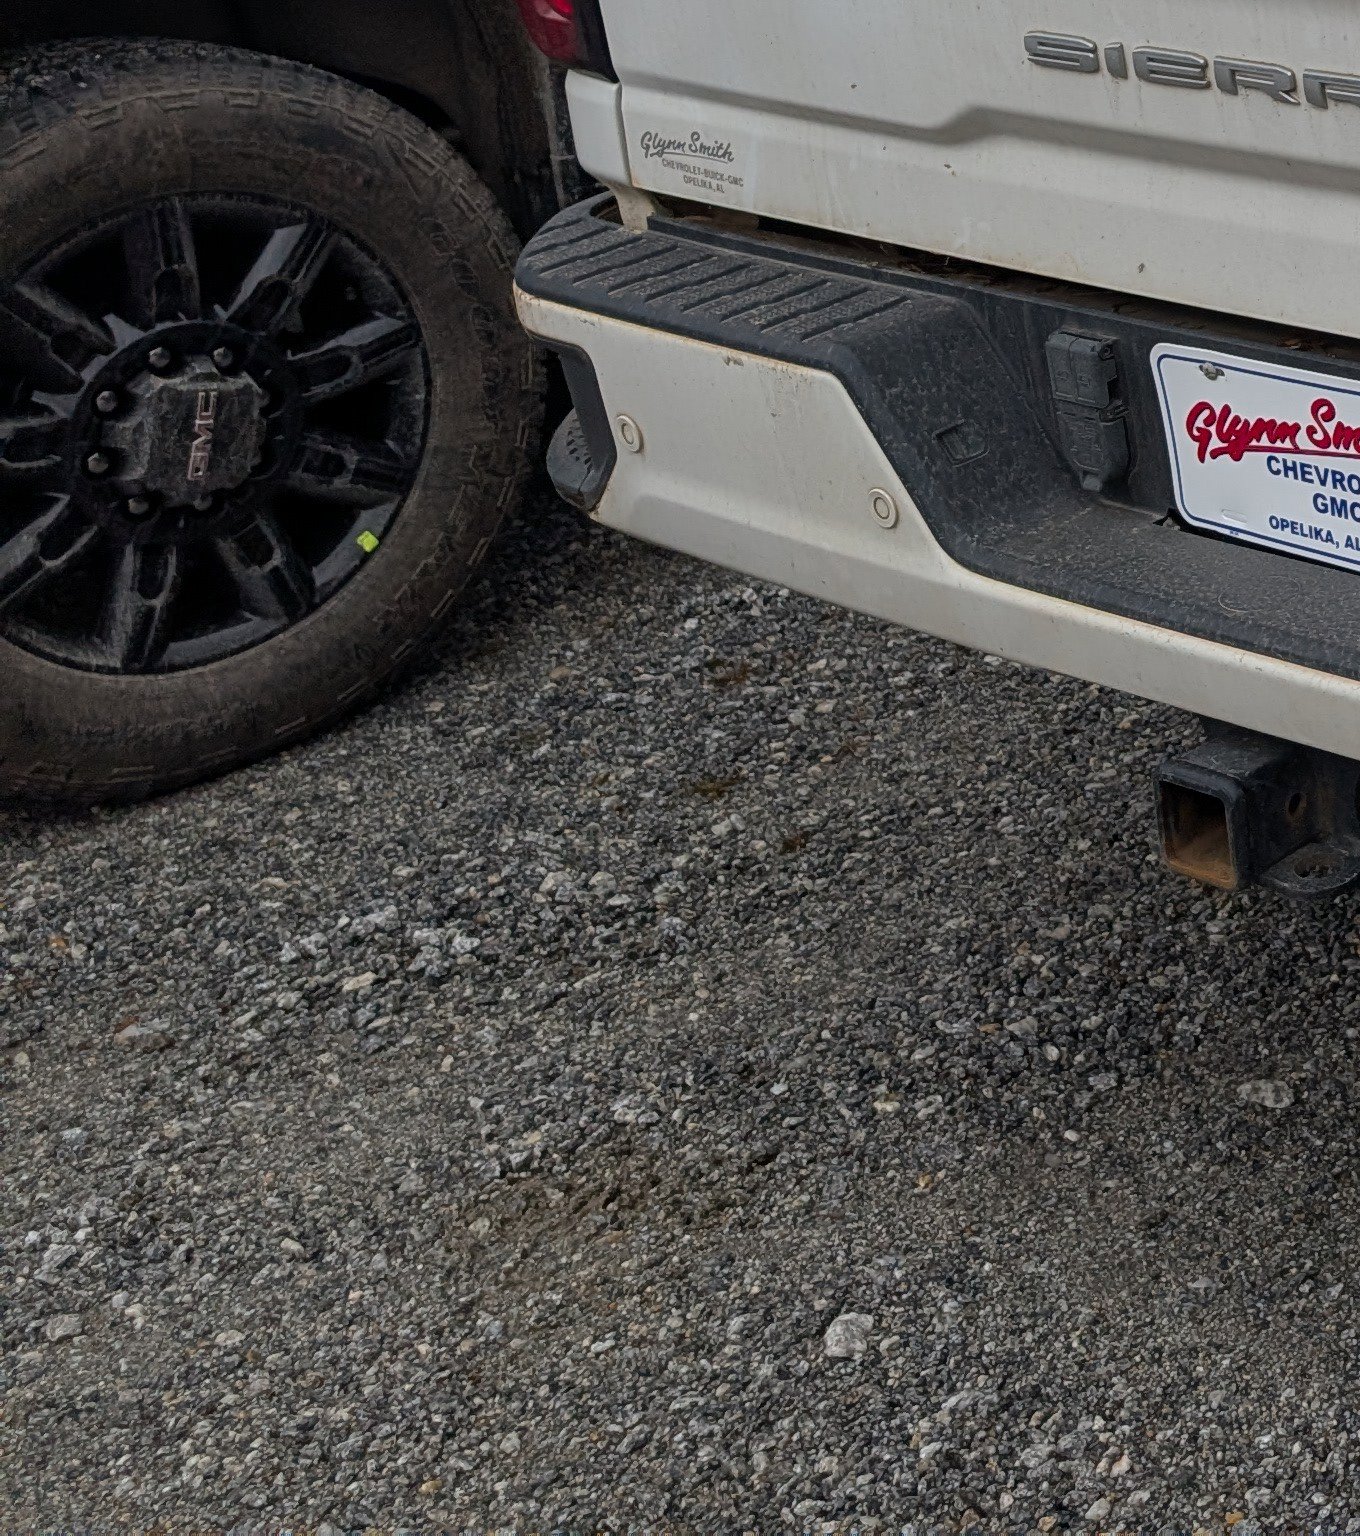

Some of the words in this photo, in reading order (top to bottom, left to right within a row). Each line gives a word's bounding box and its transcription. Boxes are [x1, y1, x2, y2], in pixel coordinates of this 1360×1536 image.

[640, 131, 686, 158] Glynn
[688, 131, 735, 163] Smith
[187, 390, 217, 482] GMC
[1186, 400, 1301, 464] Glynn
[1268, 515, 1340, 550] OPELIKA,
